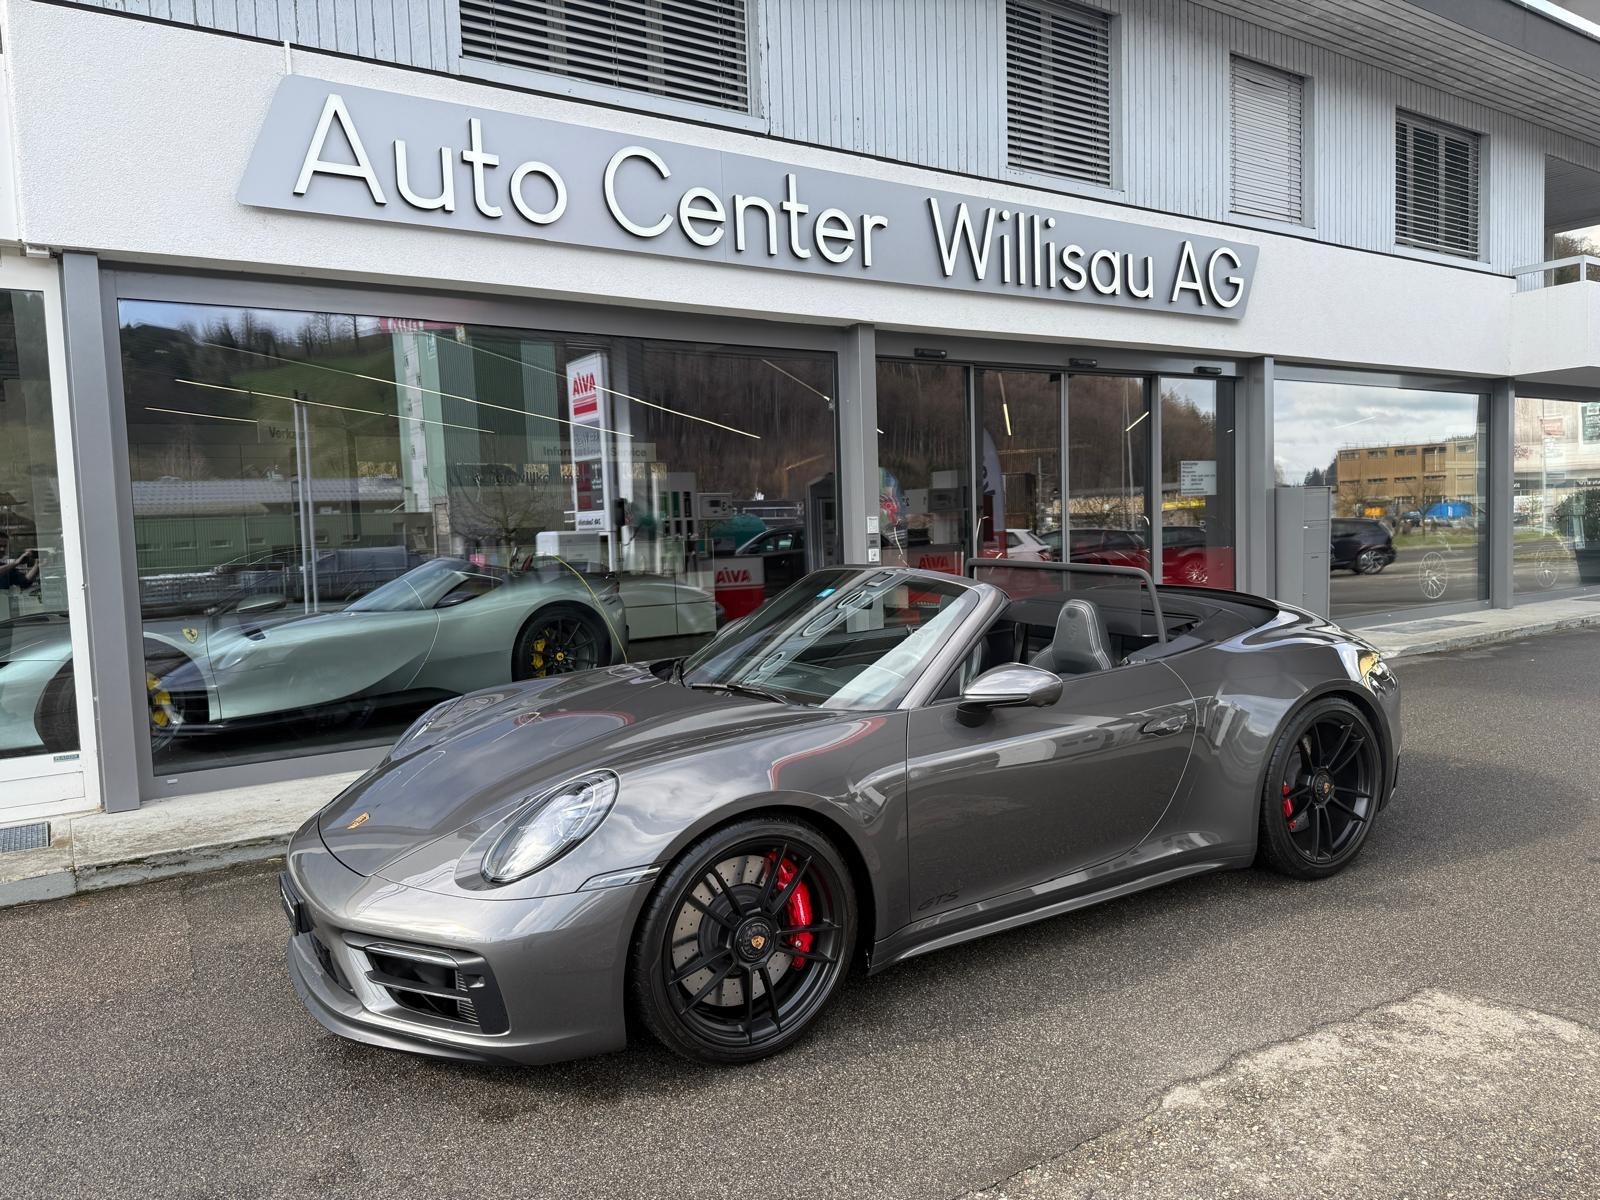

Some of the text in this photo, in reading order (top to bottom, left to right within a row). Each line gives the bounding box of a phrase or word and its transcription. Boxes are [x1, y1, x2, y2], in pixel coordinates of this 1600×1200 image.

[293, 94, 1245, 309] Auto Center Willisau AG
[917, 889, 960, 911] GTS
